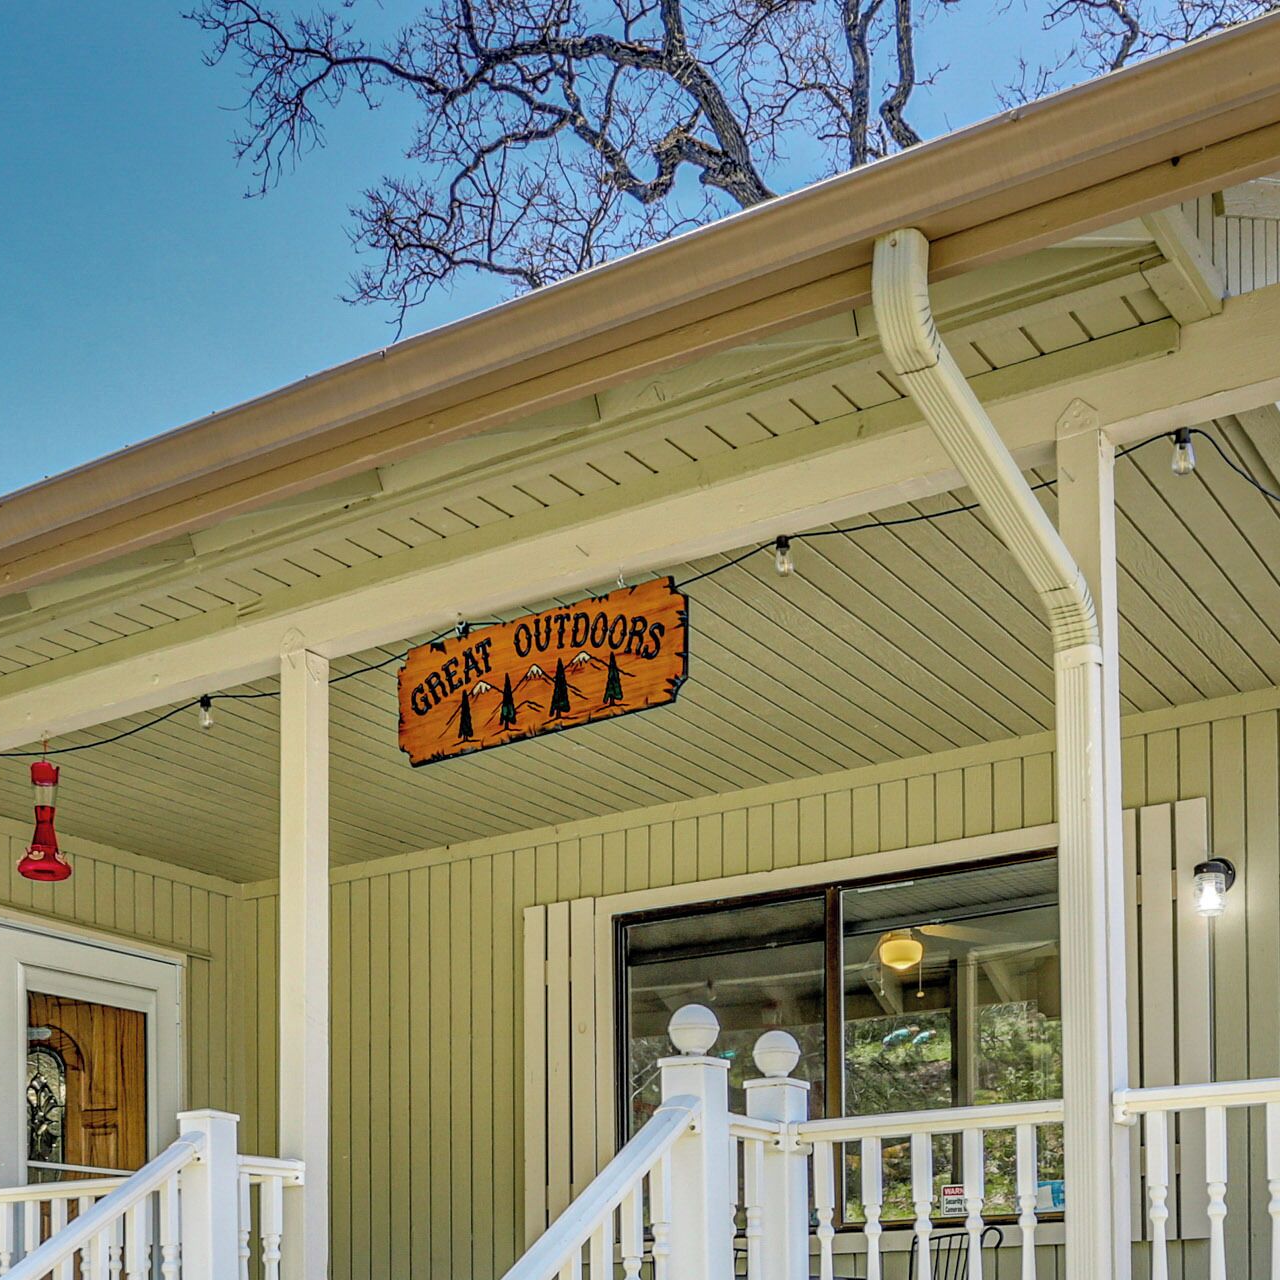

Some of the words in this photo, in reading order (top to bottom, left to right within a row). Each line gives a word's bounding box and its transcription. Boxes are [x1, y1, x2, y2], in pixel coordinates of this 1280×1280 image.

[411, 637, 492, 716] GREAT
[513, 611, 665, 660] OUTDOORS
[944, 1187, 964, 1195] WARN
